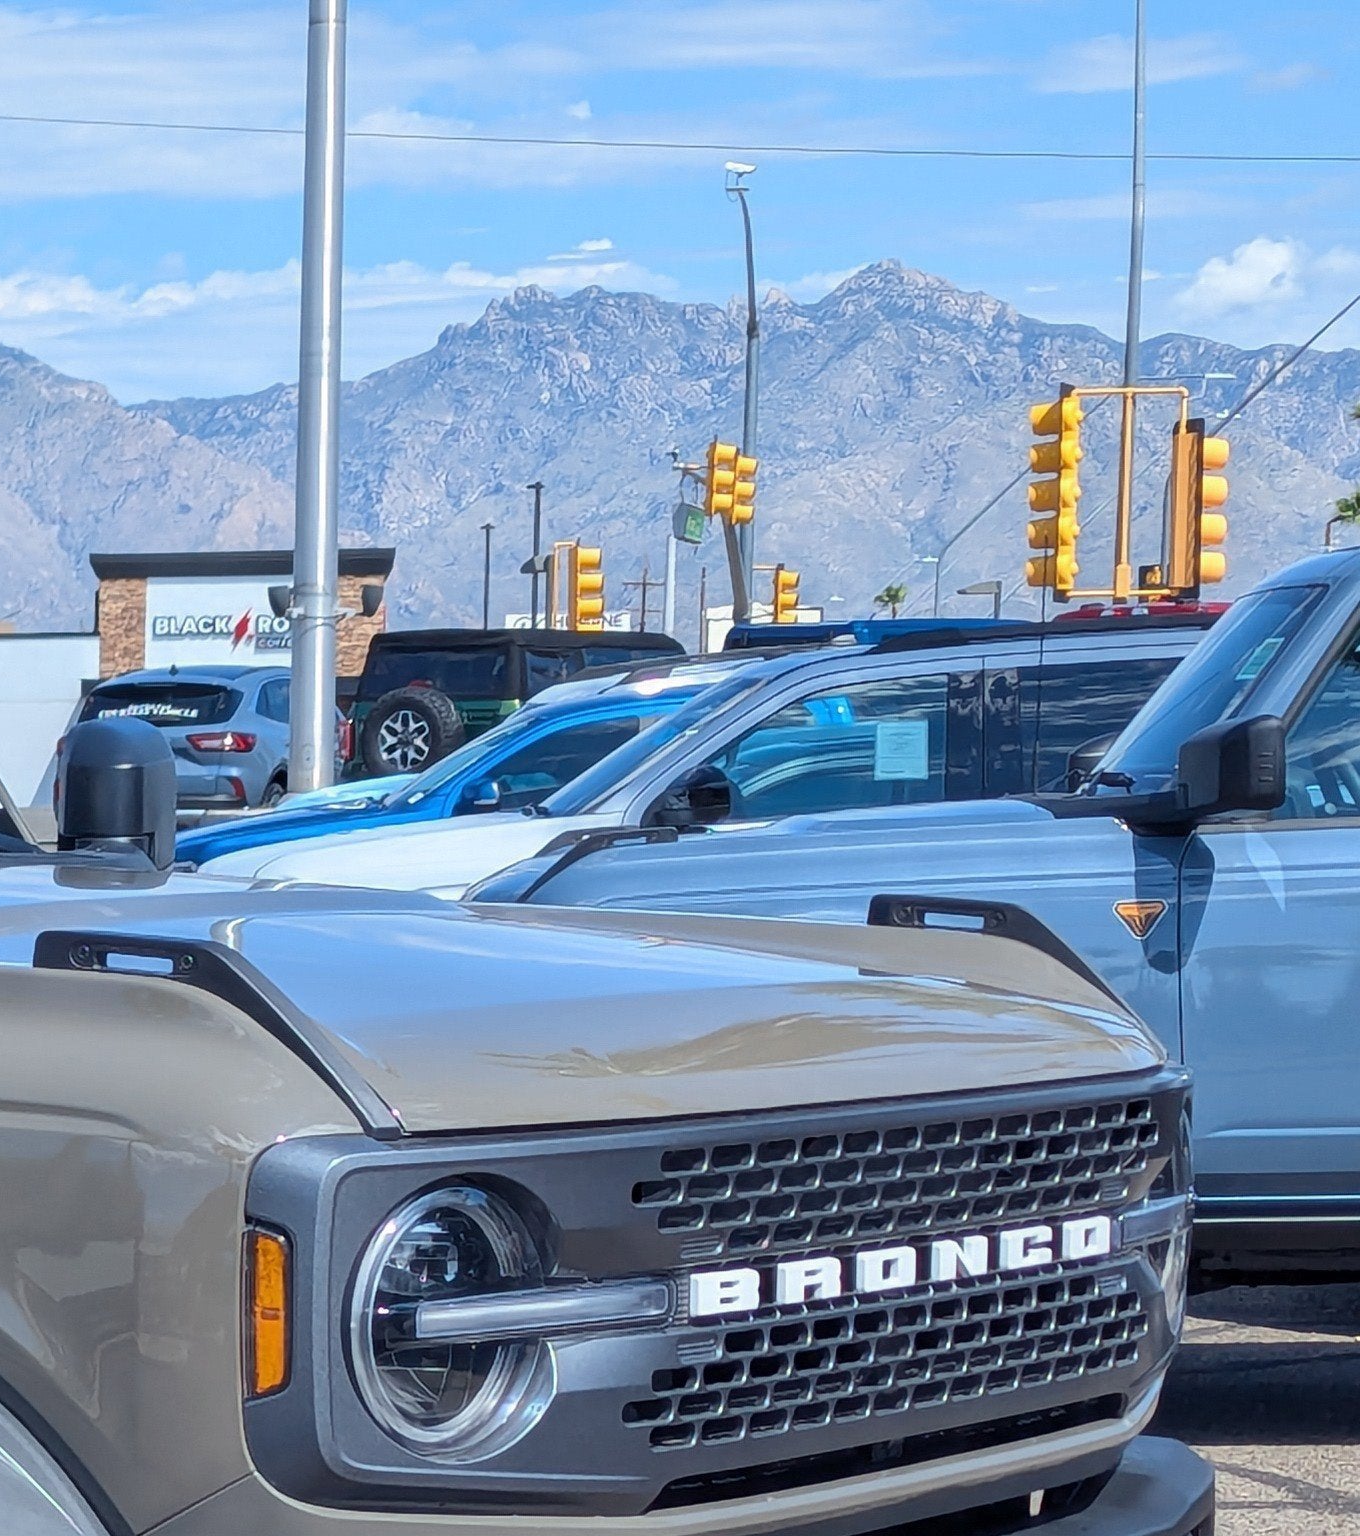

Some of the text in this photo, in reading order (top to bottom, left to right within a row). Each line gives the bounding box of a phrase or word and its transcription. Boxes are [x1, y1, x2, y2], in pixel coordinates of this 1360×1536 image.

[153, 615, 291, 637] BLACK RO
[689, 1215, 1111, 1318] BRONCO
